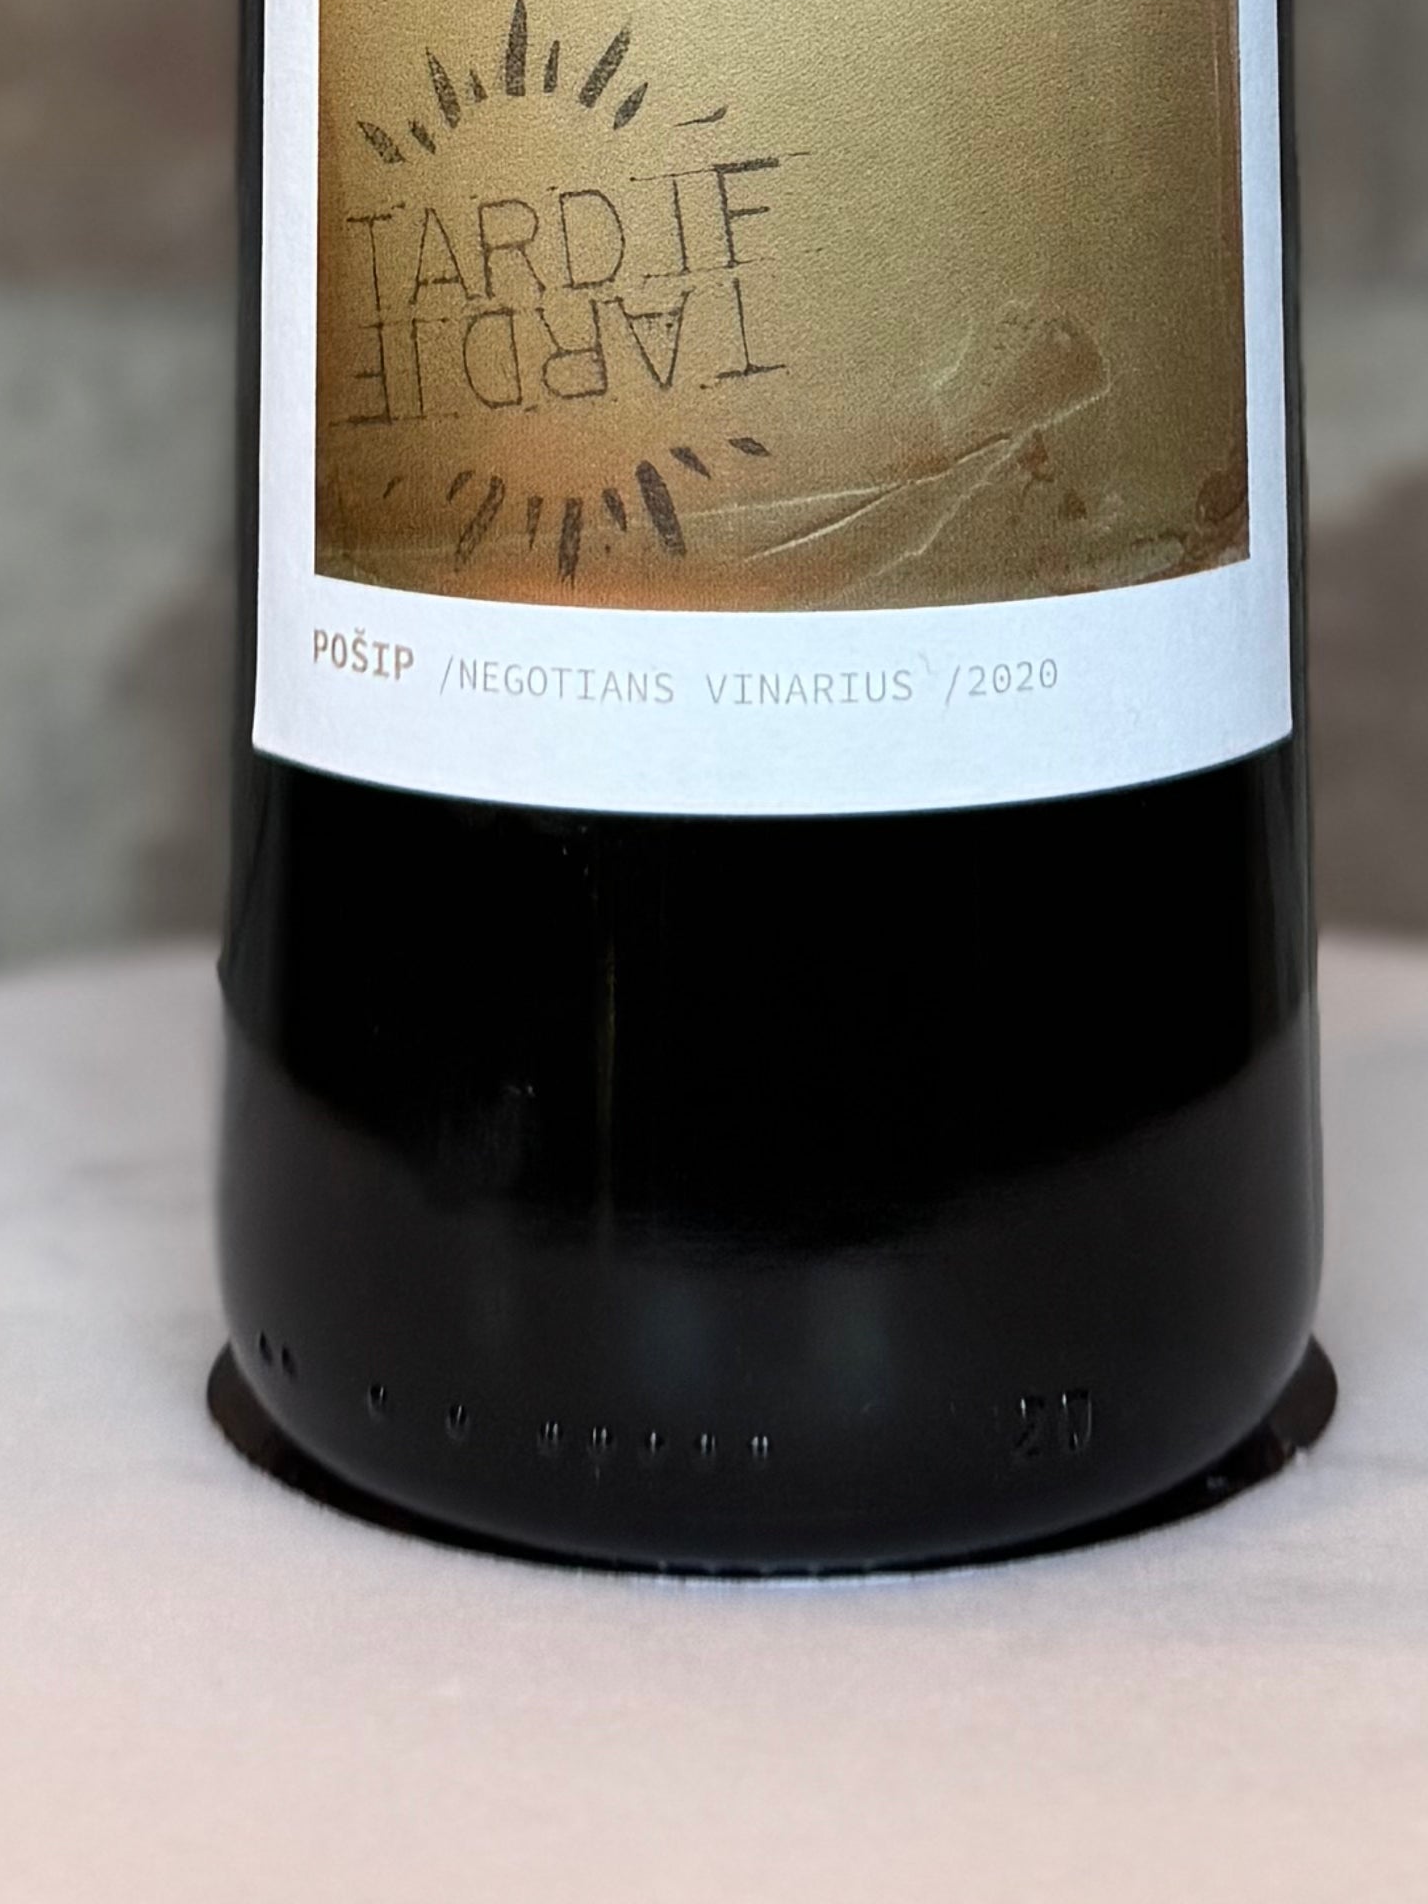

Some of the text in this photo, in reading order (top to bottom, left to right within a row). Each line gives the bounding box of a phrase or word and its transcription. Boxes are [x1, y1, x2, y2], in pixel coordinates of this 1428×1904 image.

[346, 154, 784, 310] TARDIF
[312, 626, 1059, 707] POŠIP /NEGOTIANS VINARIUS /2020
